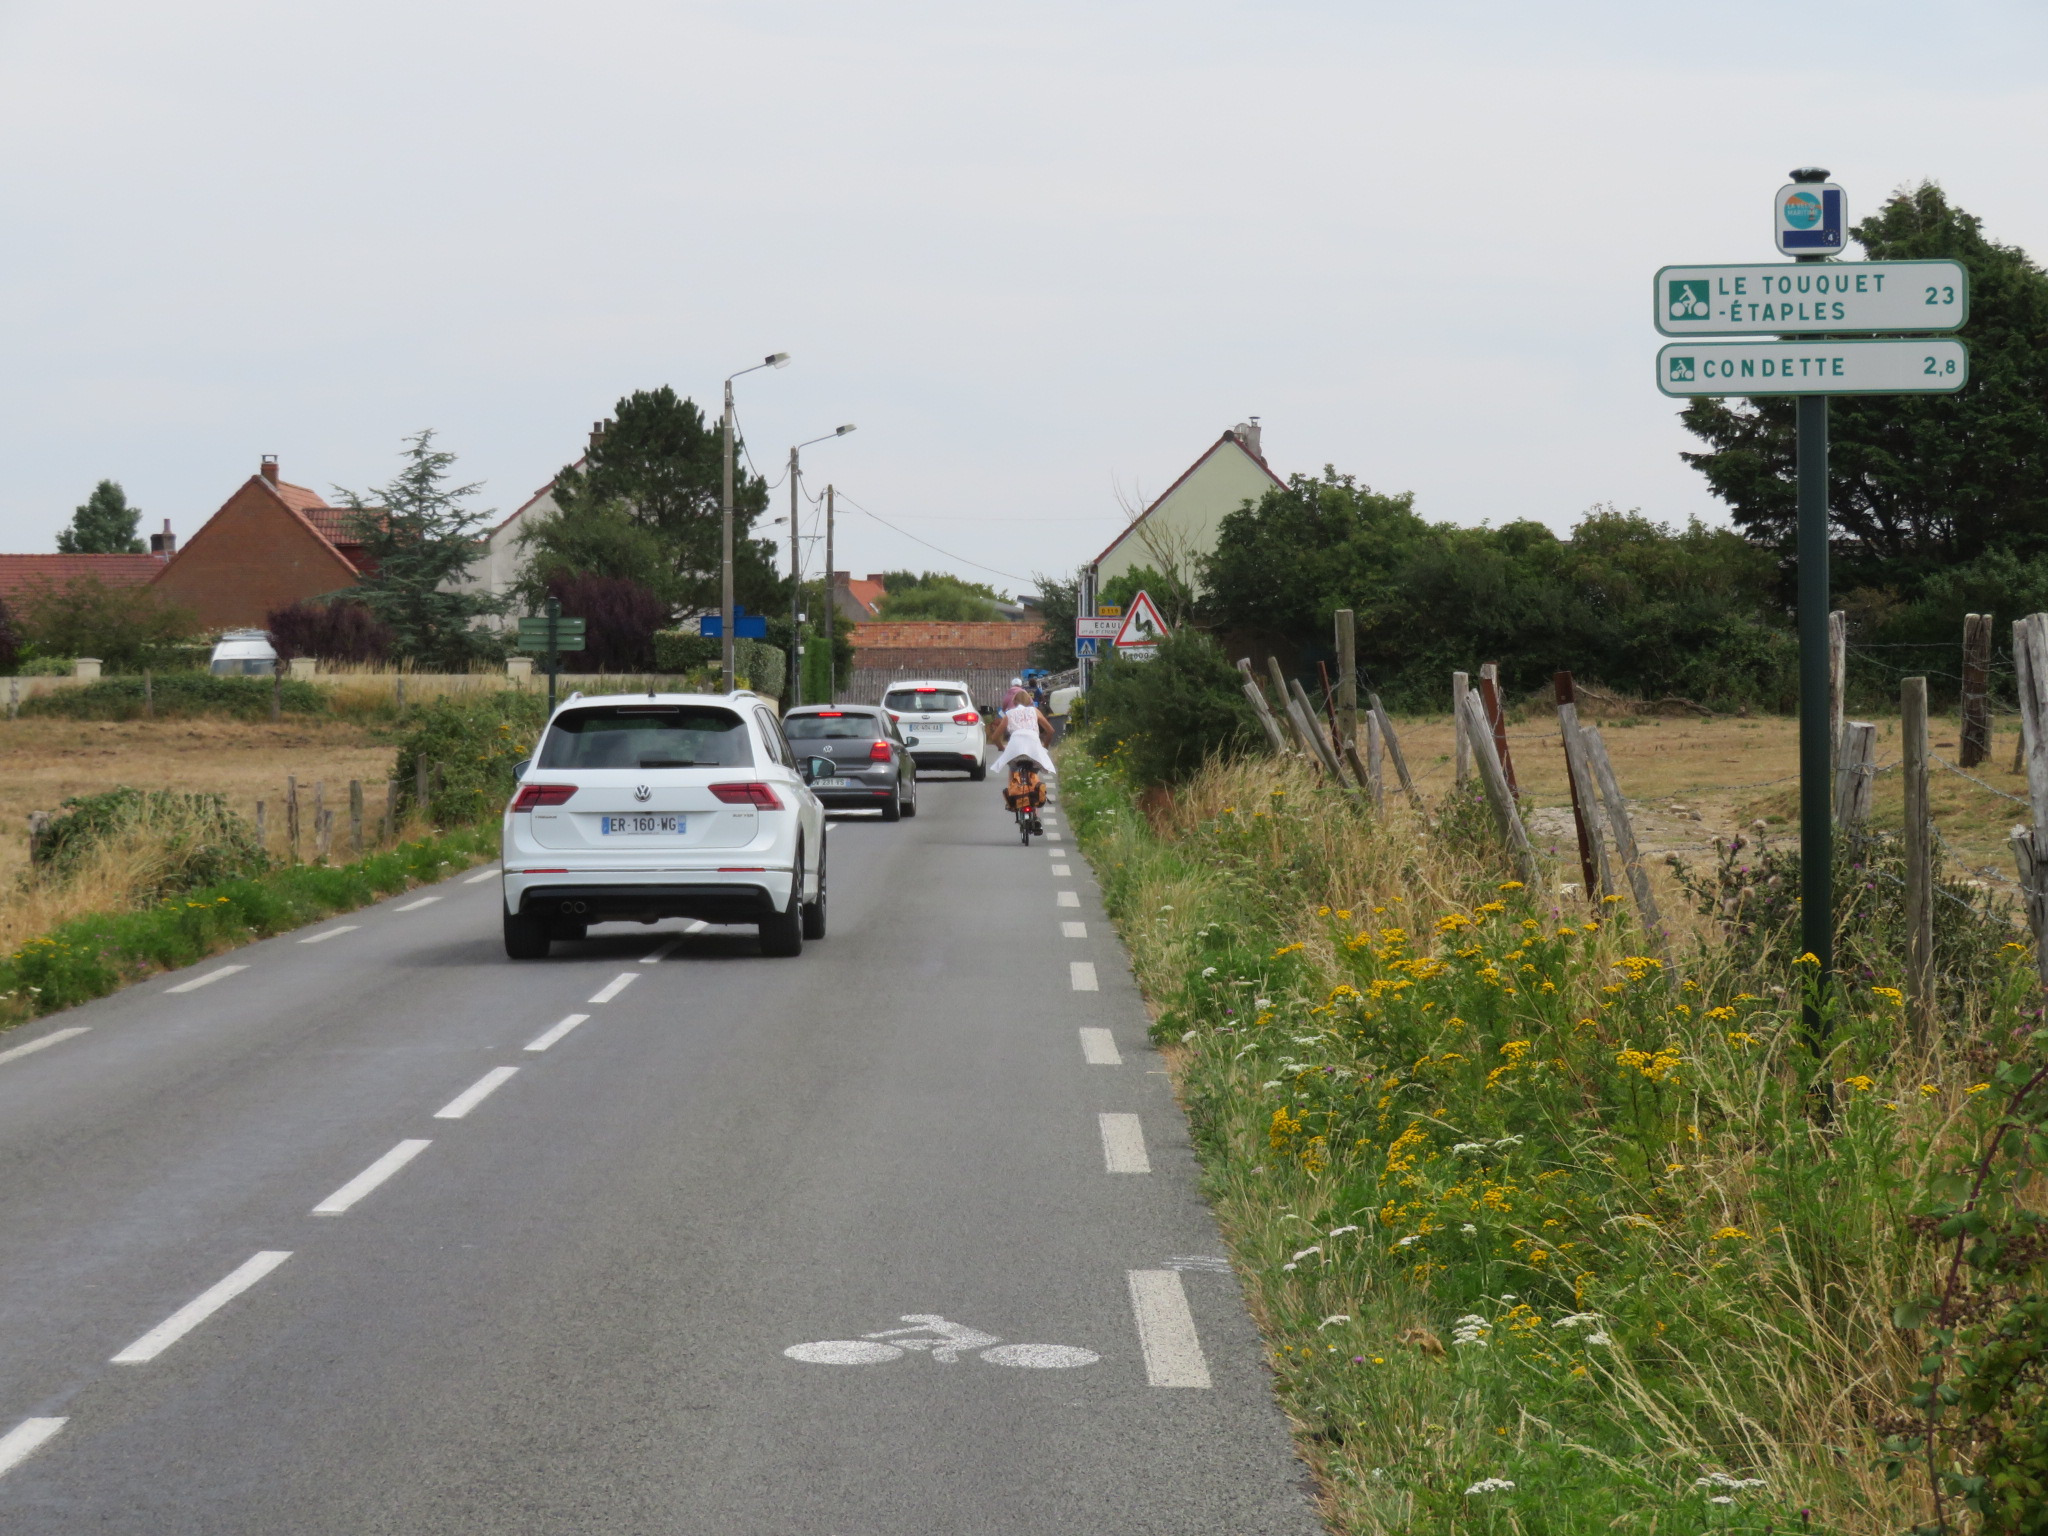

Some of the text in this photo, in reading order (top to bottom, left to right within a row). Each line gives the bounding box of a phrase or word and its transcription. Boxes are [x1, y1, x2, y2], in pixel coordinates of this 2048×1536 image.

[1719, 274, 1886, 296] LE TOUQUET
[1925, 286, 1955, 305] 23
[1719, 300, 1846, 322] -ÉTAPLES
[1703, 357, 1845, 378] CONDETTE
[1923, 356, 1956, 377] 2,8
